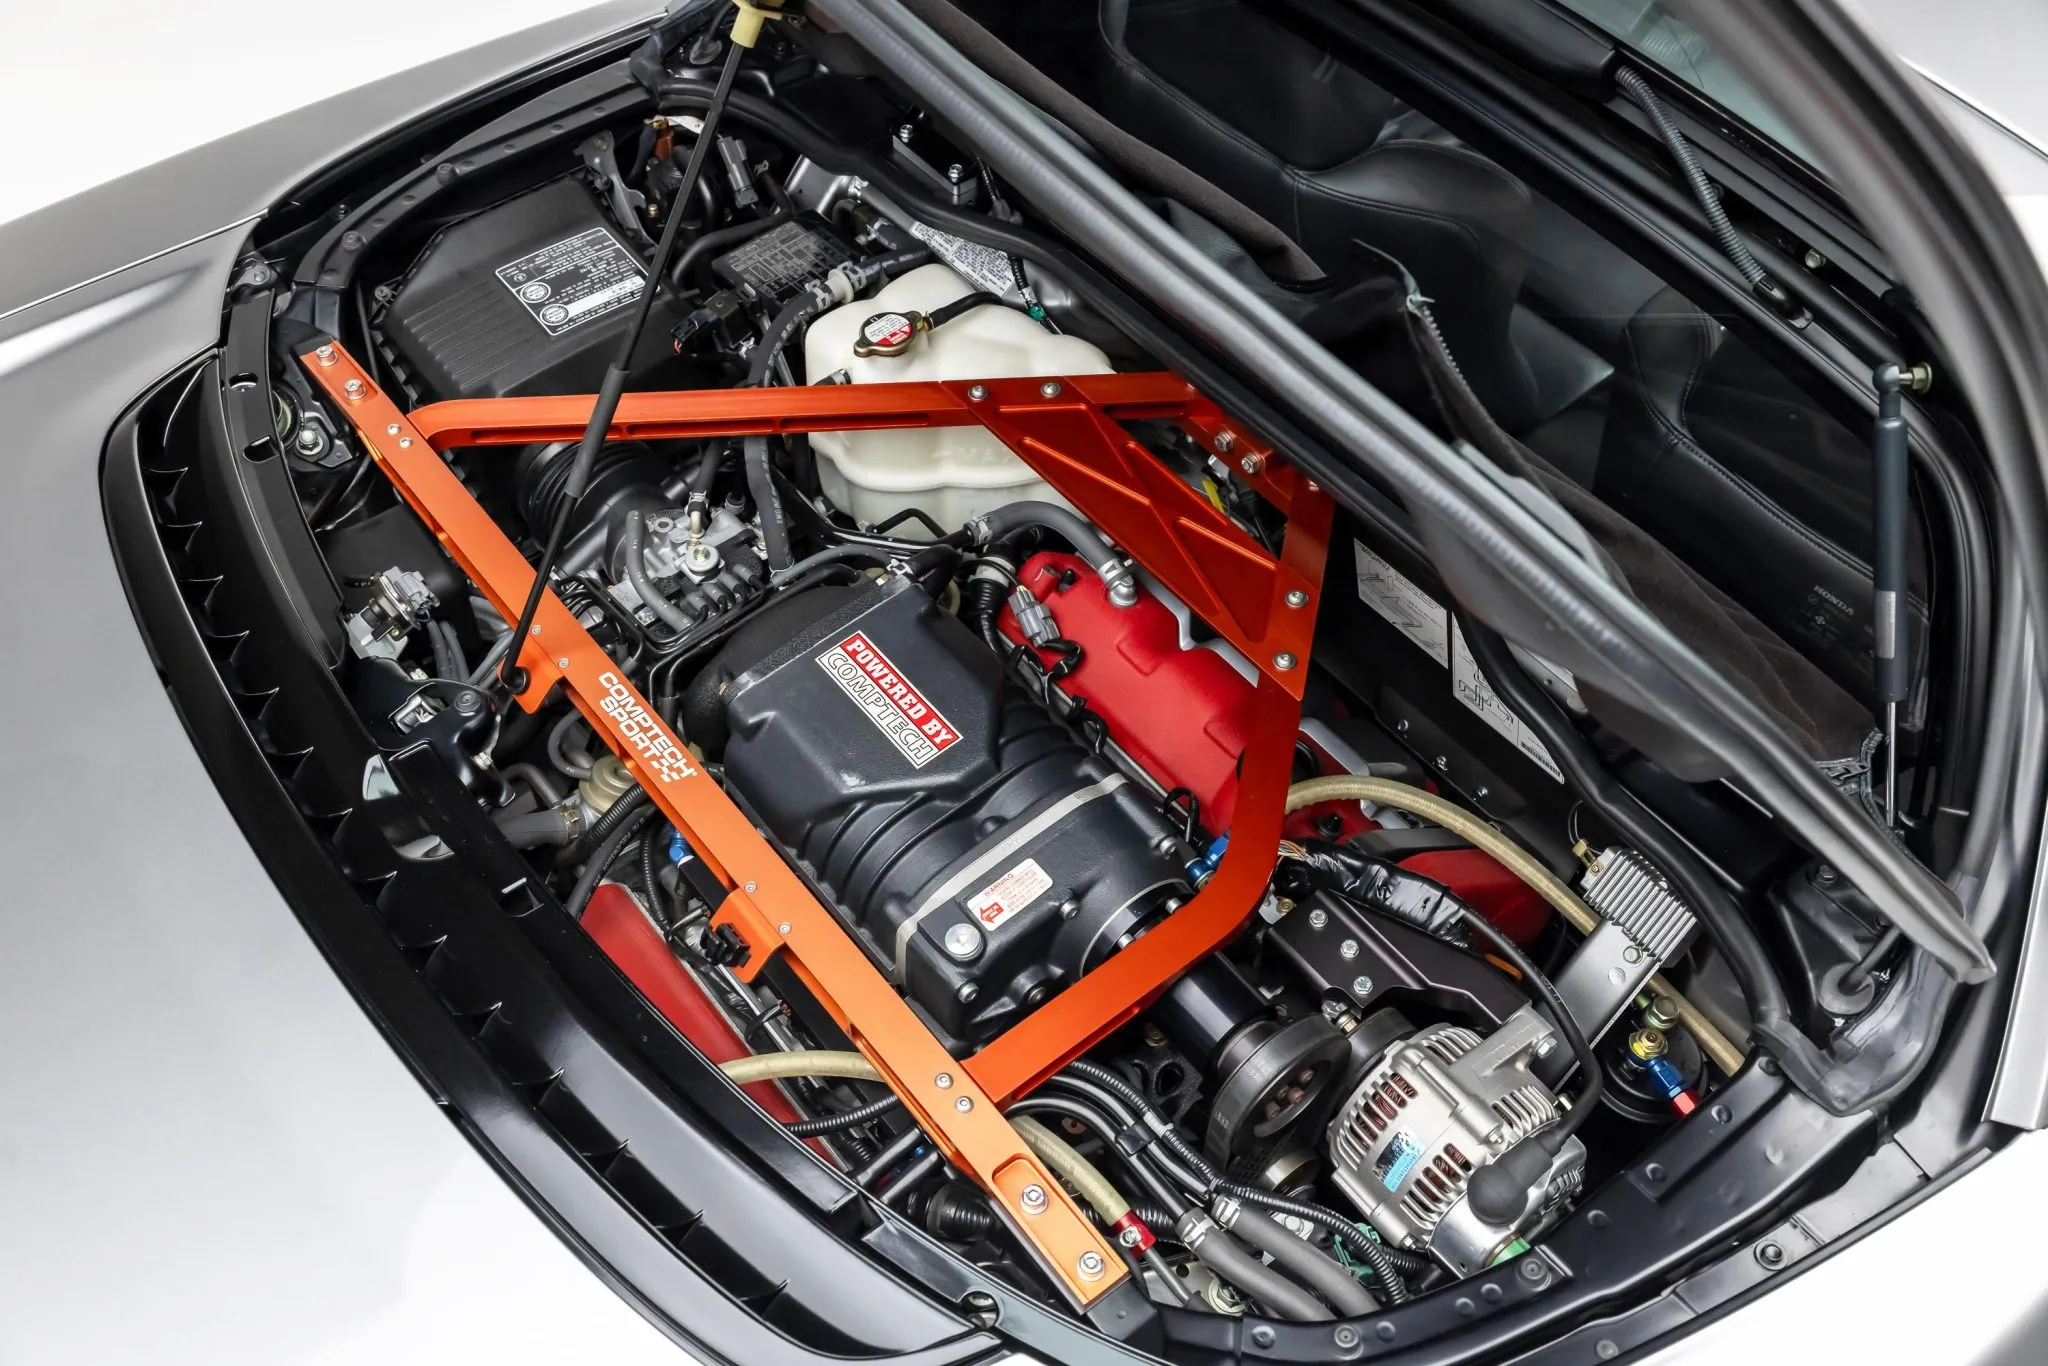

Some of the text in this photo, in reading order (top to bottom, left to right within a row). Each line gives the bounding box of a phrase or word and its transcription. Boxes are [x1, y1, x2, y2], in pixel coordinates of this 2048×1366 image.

[1813, 585, 1855, 616] HONDA
[598, 671, 697, 778] COMPTECH
[599, 695, 662, 758] SPORT
[827, 652, 934, 760] COMPTECH
[845, 638, 954, 745] POWERED BY
[983, 872, 1015, 897] WARNING
